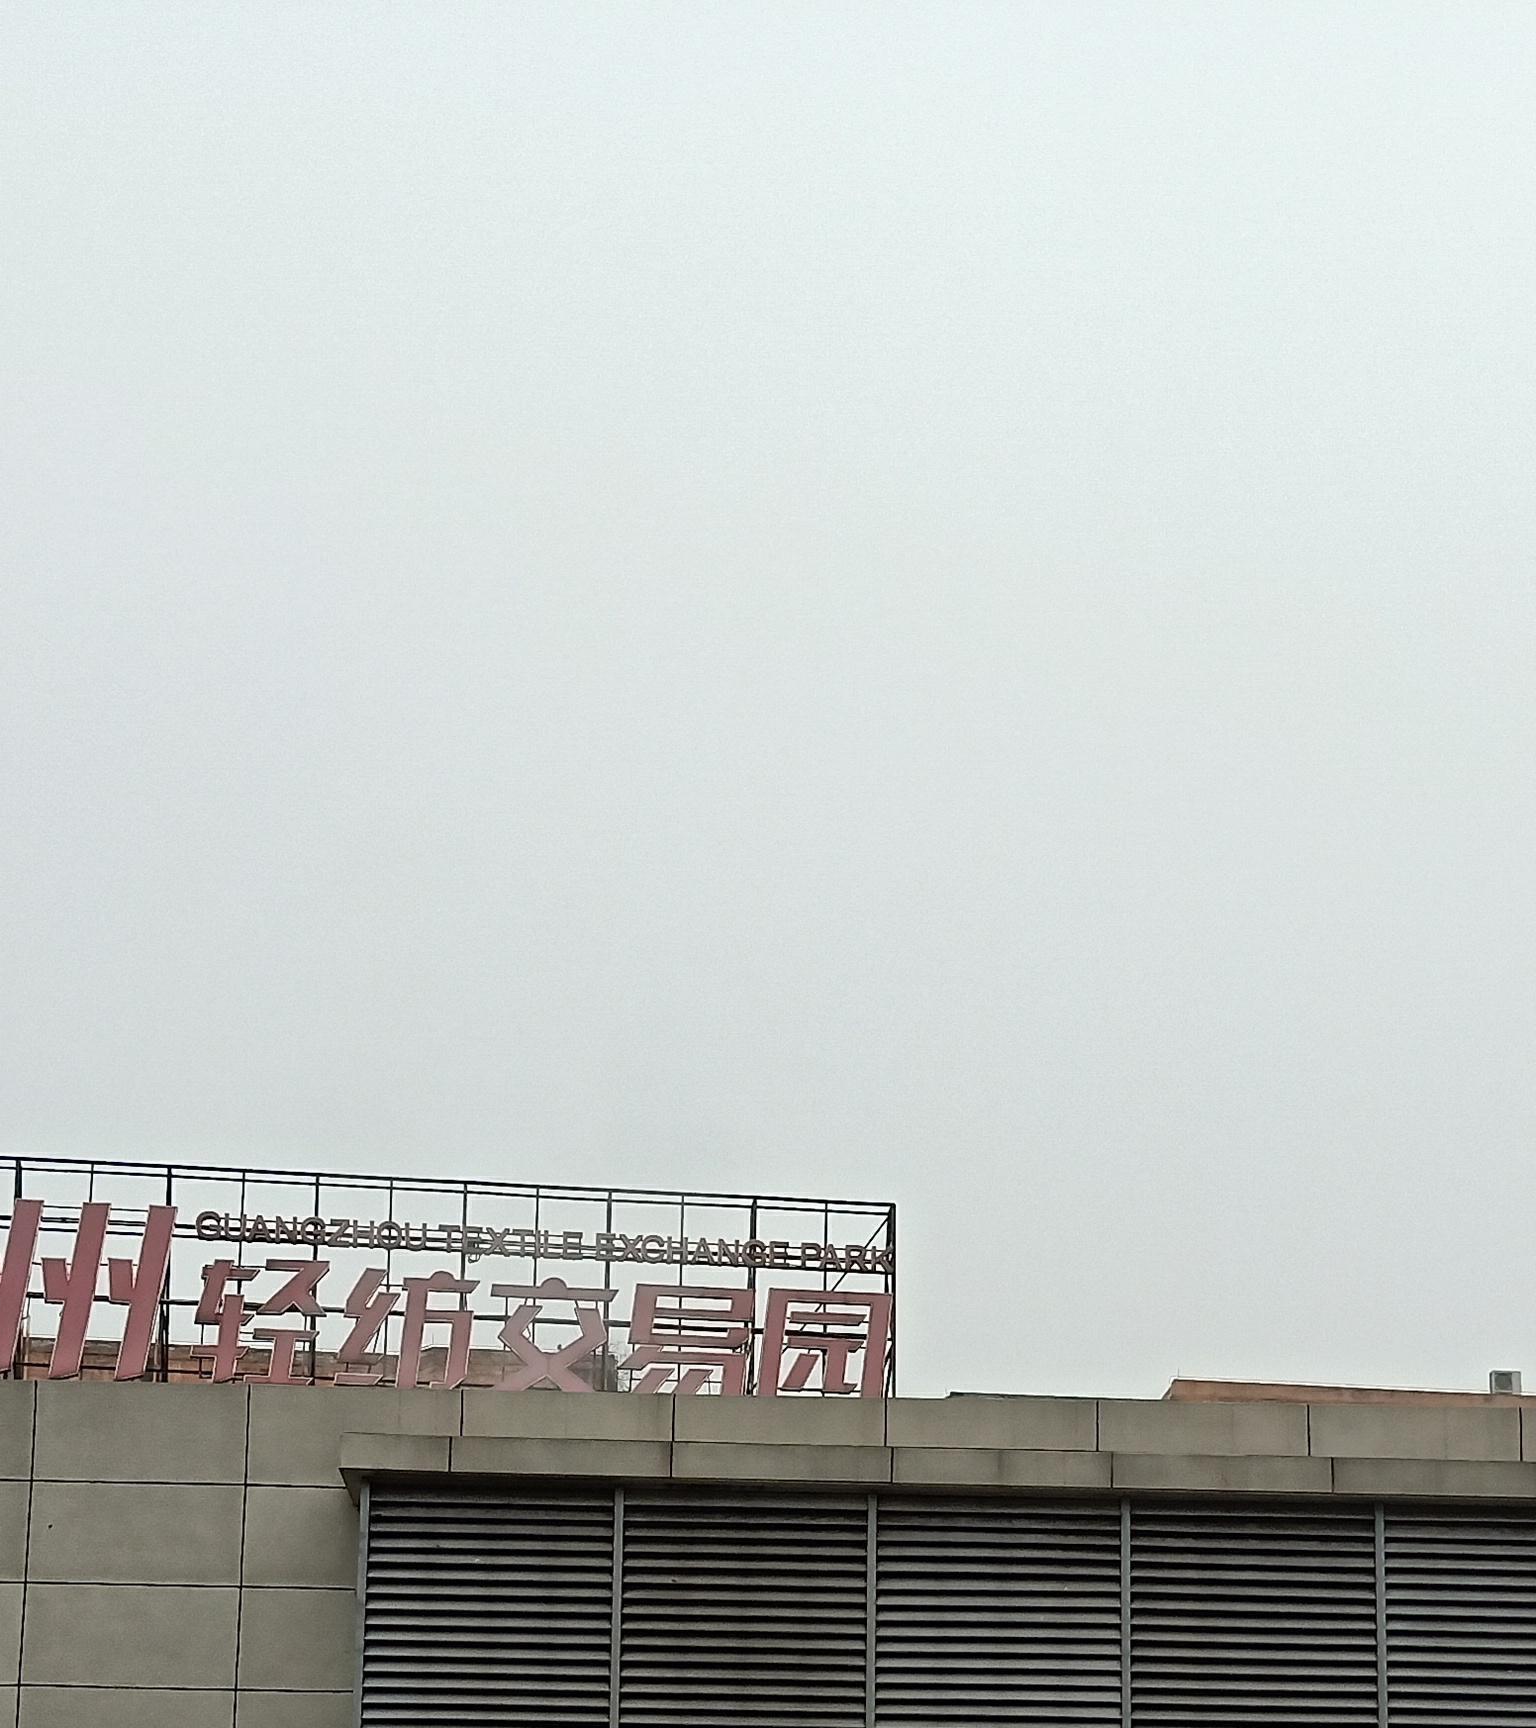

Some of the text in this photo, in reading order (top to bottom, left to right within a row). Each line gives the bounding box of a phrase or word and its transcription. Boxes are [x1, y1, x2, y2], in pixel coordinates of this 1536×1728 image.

[195, 1211, 892, 1273] GUANGZHOU TEXTILE EXCHANGE PARK
